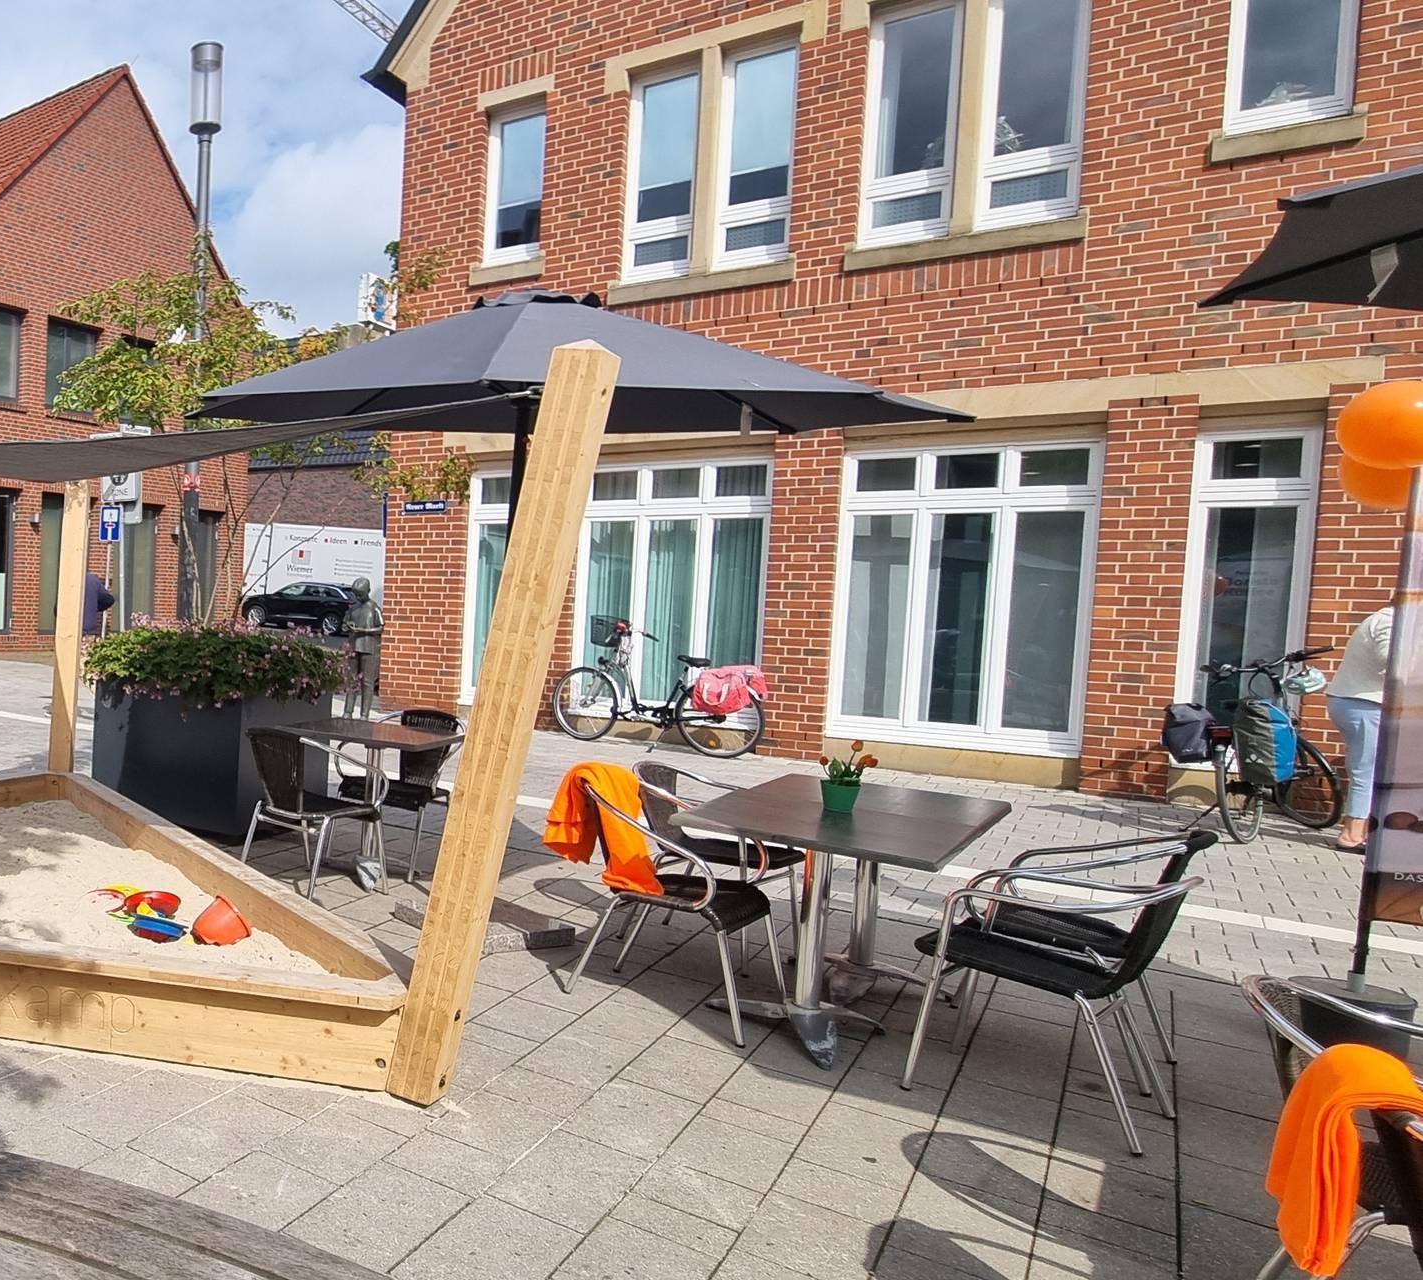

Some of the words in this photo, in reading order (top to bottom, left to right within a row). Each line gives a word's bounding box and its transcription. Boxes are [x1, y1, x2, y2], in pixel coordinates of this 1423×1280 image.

[329, 537, 348, 545] Ideen
[360, 538, 383, 548] Trends
[286, 563, 314, 574] Wiemer
